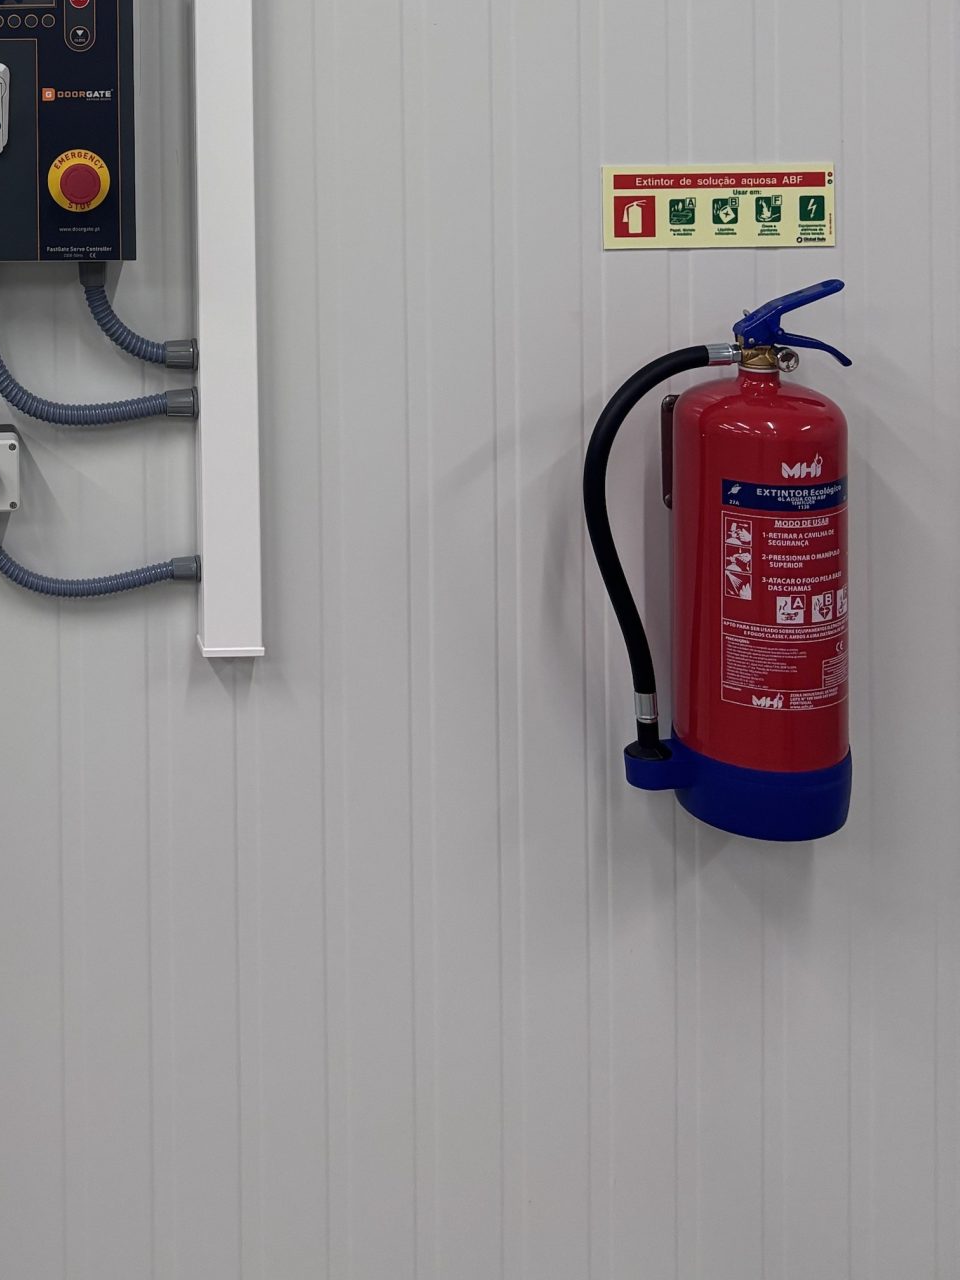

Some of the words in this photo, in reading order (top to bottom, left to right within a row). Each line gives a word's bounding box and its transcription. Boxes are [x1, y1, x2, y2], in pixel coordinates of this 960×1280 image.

[57, 90, 112, 98] DOORGATE
[54, 151, 105, 170] EMERGENCY
[635, 177, 674, 187] Extintor
[679, 177, 692, 186] de
[697, 176, 736, 188] solução
[740, 176, 777, 187] aquosa
[782, 175, 803, 184] ABF
[687, 199, 694, 207] A
[731, 198, 737, 206] B
[774, 196, 780, 204] F
[756, 488, 809, 497] EXTINTOR
[810, 484, 842, 497] Ecológico
[774, 519, 800, 528] MODO
[801, 519, 812, 527] DE
[812, 517, 829, 526] USAR
[762, 531, 798, 539] 1-RETIRAR
[804, 530, 828, 539] CAVILHA
[768, 539, 809, 547] SEGURANÇA
[762, 553, 810, 561] 2-PRESSIONAR
[762, 576, 796, 584] 3-ATACAR
[802, 576, 820, 584] FOGO
[783, 584, 811, 592] CHAMAS
[793, 597, 804, 609] A
[825, 593, 832, 605] B
